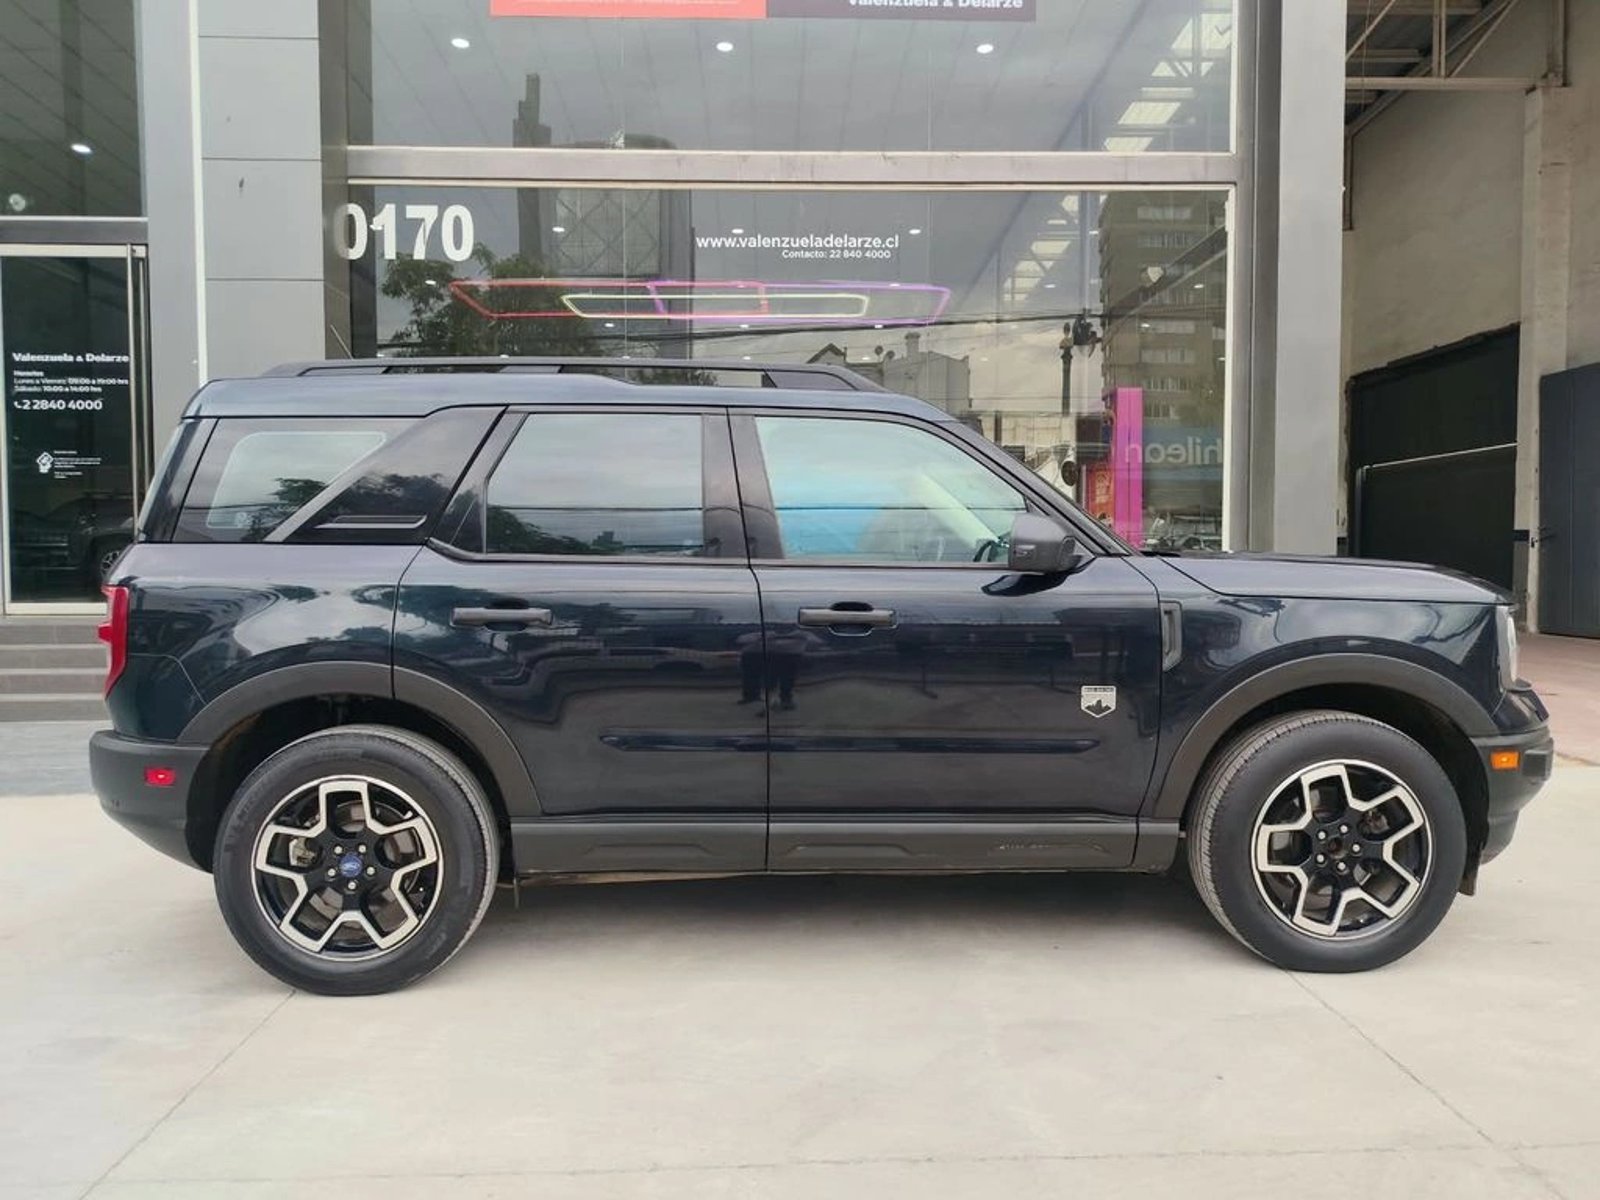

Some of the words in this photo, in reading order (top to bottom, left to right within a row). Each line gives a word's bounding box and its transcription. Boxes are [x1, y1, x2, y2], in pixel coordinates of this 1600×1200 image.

[334, 203, 474, 262] 0170
[696, 234, 899, 248] www.valenzueladelarze.cl
[782, 249, 827, 259] Contacto:
[829, 249, 841, 259] 22
[843, 249, 862, 259] 840
[864, 249, 892, 259] 4000
[12, 352, 74, 362] Valenzuela
[85, 353, 130, 362] Delarze
[33, 399, 66, 410] 2840
[67, 399, 103, 410] 4000
